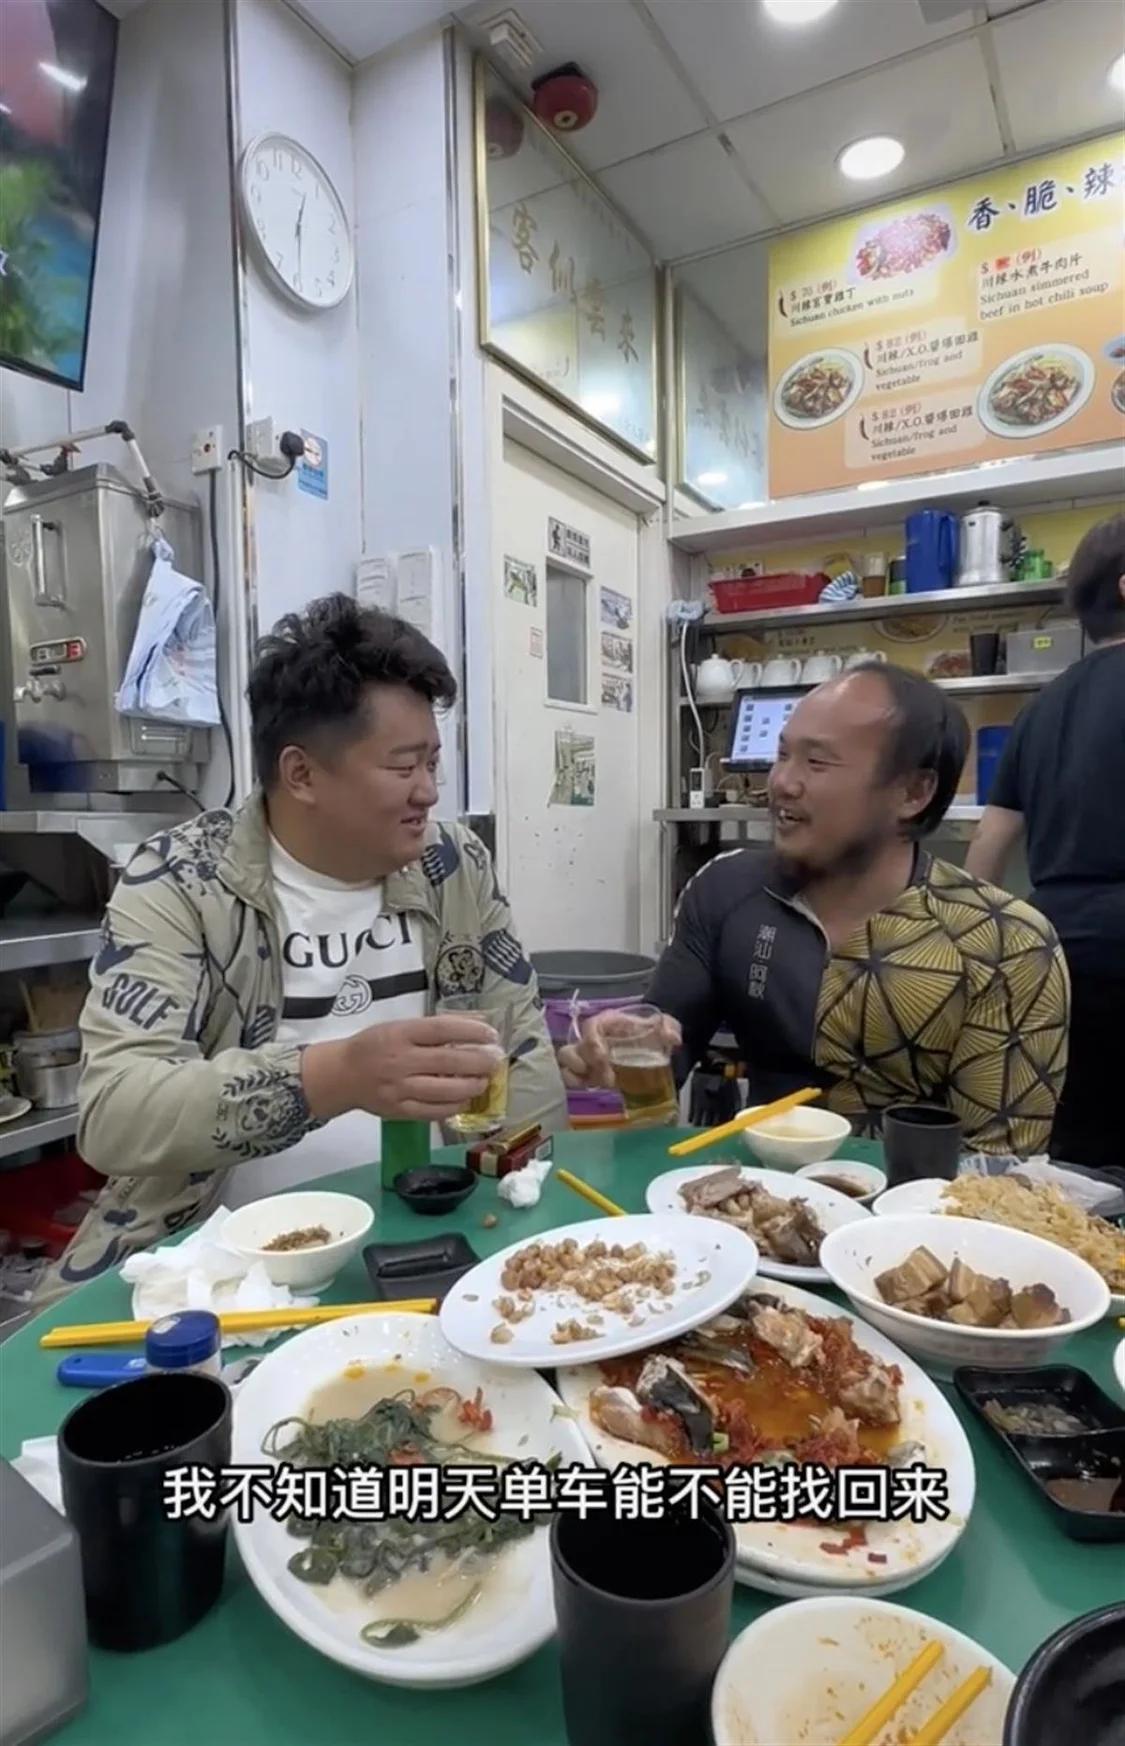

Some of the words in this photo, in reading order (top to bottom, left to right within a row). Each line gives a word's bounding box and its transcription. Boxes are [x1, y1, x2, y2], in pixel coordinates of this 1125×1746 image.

[968, 162, 1115, 231] 香、脆、辣
[102, 972, 180, 1031] GOLF
